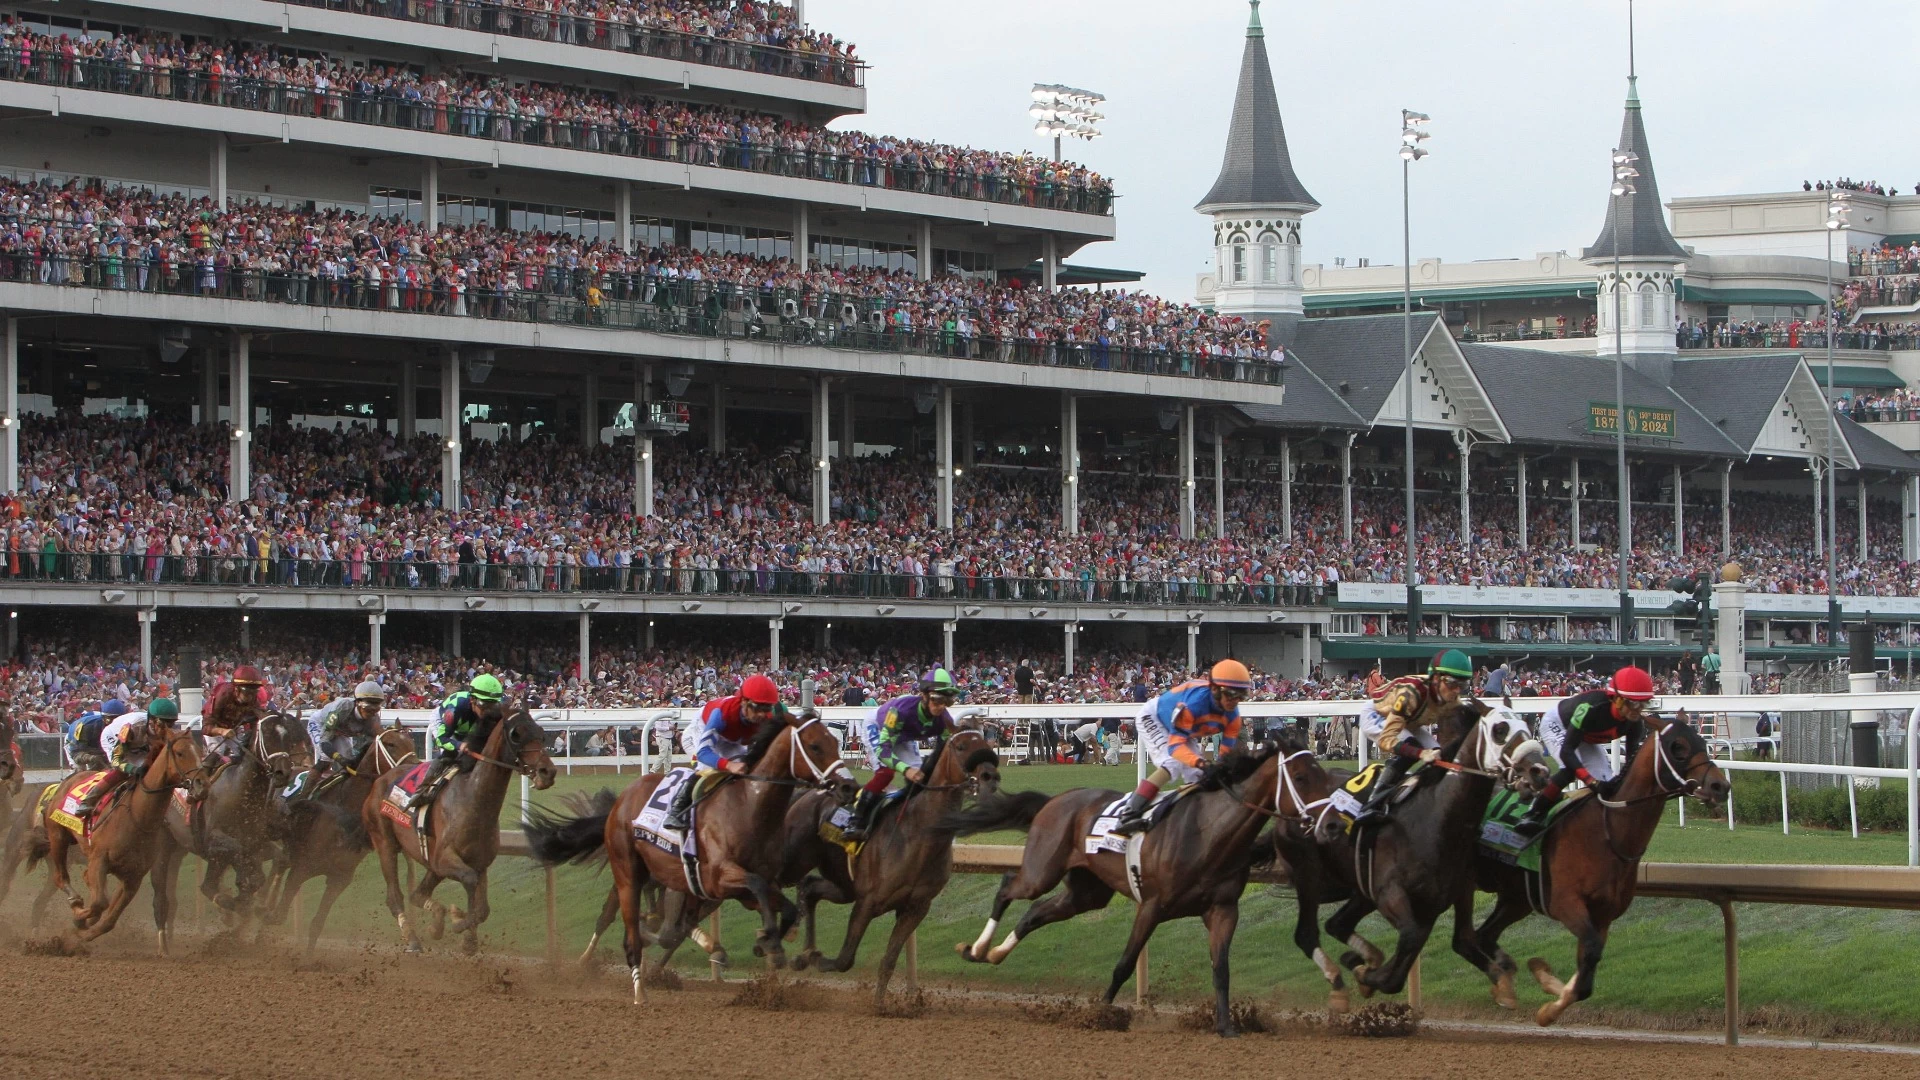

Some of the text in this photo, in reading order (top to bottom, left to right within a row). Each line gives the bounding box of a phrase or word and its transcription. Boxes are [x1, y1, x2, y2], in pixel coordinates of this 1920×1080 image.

[1591, 407, 1618, 417] FIRST DER
[1652, 412, 1672, 421] DERBY
[1641, 420, 1668, 433] 2024
[1636, 593, 1667, 605] CHURCHILL
[1393, 695, 1406, 712] 6
[326, 713, 338, 726] 5
[634, 828, 673, 852] EPIC RIDE
